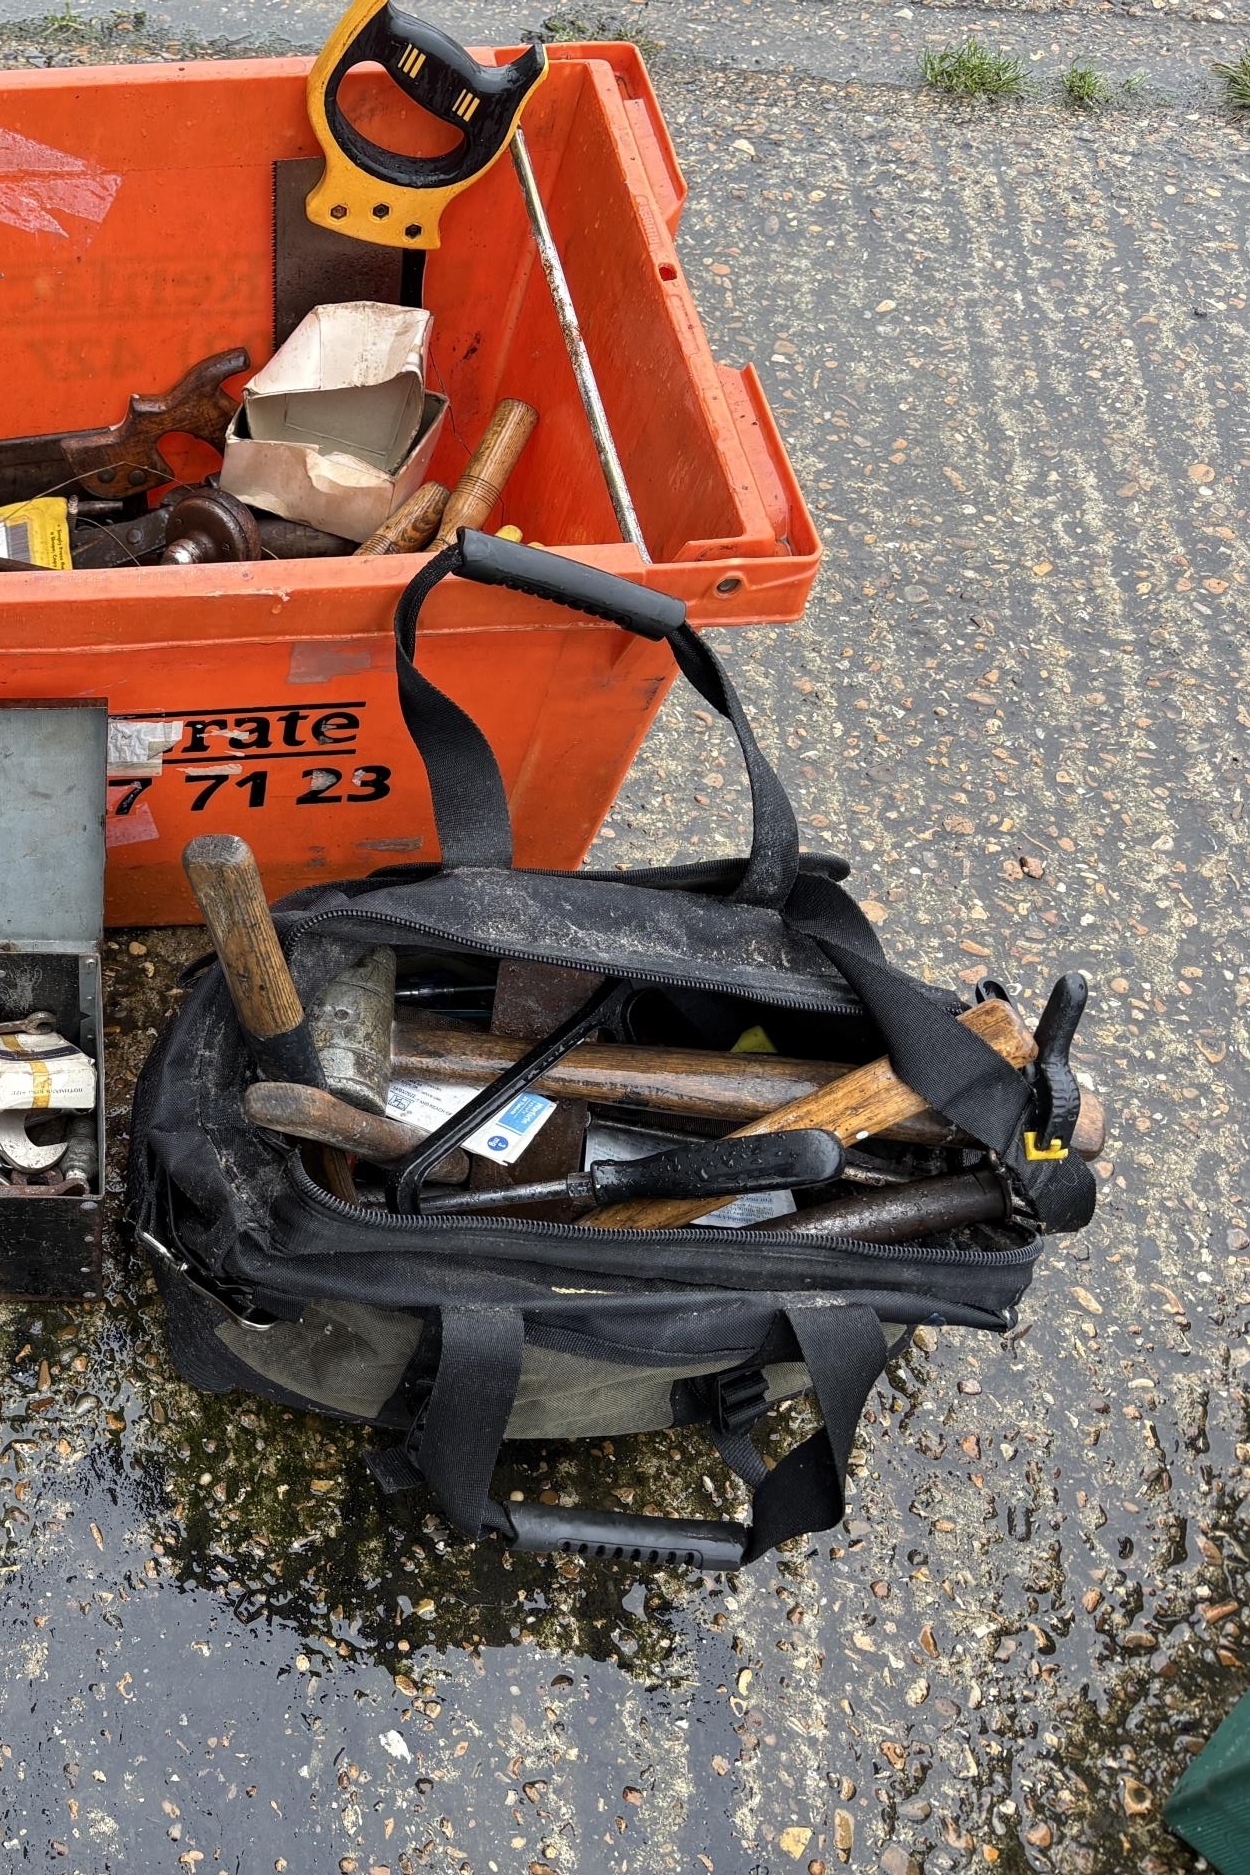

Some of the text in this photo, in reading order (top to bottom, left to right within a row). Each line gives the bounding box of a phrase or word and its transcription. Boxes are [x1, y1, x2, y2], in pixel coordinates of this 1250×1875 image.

[182, 711, 360, 754] rate
[109, 765, 392, 816] 7 71 23
[520, 1101, 545, 1125] Warfarin
